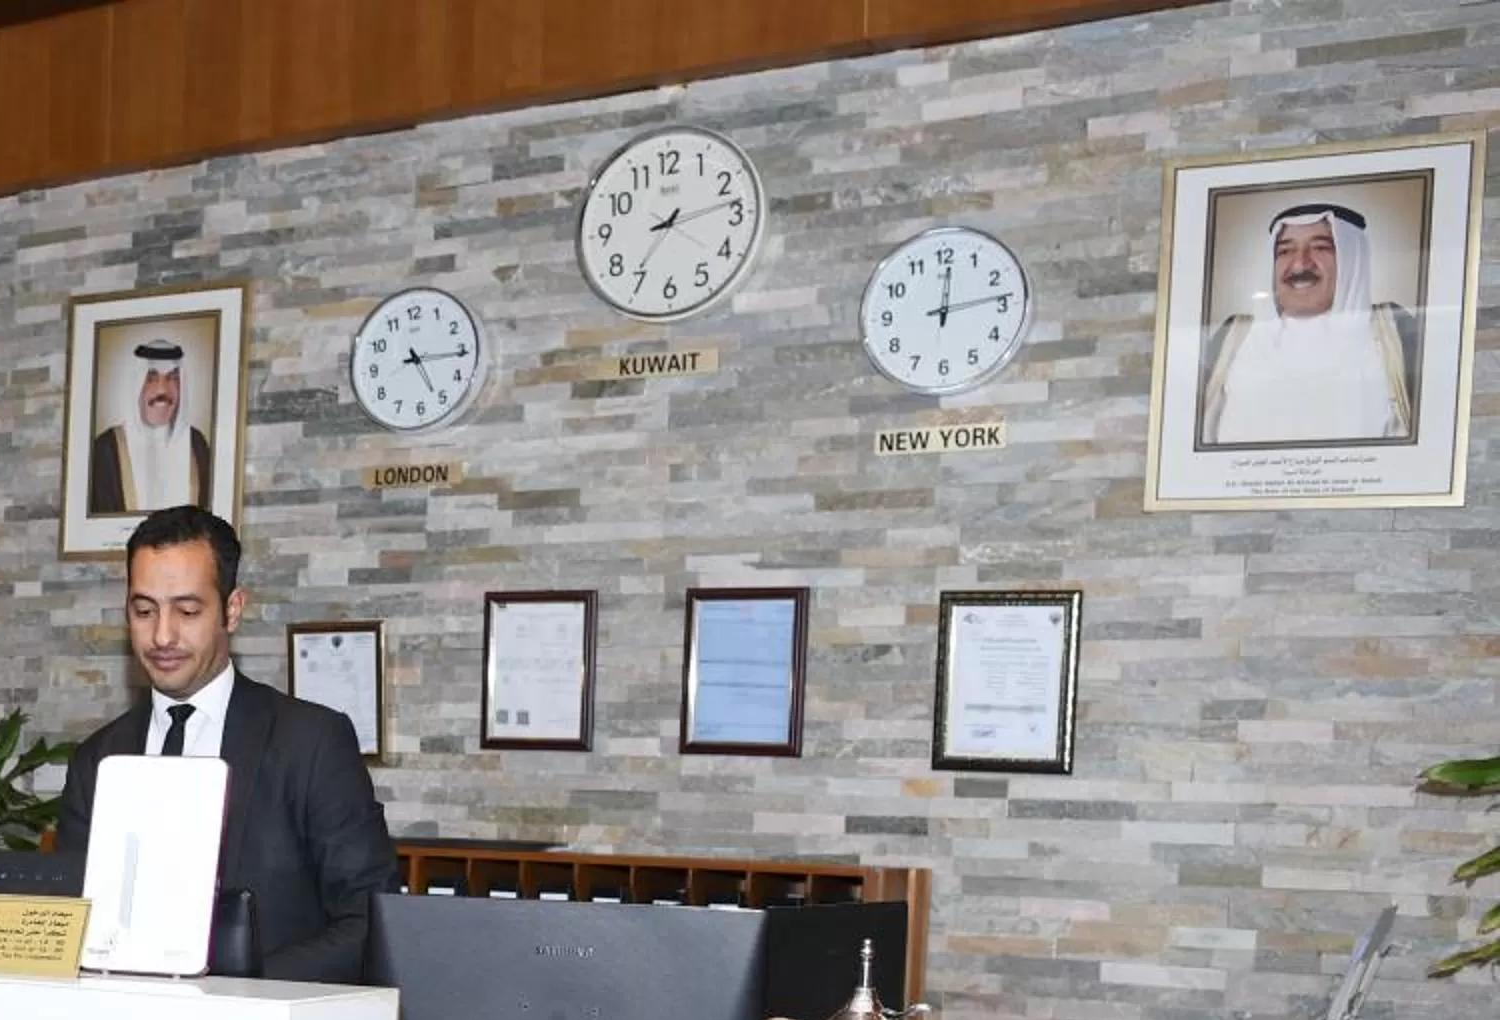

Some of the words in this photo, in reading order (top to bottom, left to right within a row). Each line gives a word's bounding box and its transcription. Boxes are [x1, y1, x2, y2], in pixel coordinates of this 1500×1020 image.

[658, 150, 680, 176] 12
[696, 152, 704, 177] 1
[631, 165, 651, 190] 11
[717, 171, 732, 196] 2
[609, 191, 633, 217] 10
[728, 201, 744, 227] 3
[597, 223, 613, 248] 9
[717, 237, 732, 260] 4
[934, 247, 954, 265] 12
[608, 253, 624, 277] 8
[908, 259, 925, 275] 11
[969, 252, 978, 269] 1
[693, 261, 710, 287] 5
[989, 270, 1001, 287] 2
[632, 271, 647, 295] 7
[663, 276, 677, 300] 6
[886, 282, 906, 299] 10
[406, 305, 422, 321] 12
[996, 296, 1009, 314] 3
[433, 307, 441, 321] 1
[881, 311, 893, 327] 9
[387, 318, 400, 333] 11
[449, 321, 460, 335] 2
[987, 326, 1000, 341] 4
[371, 338, 388, 354] 10
[457, 343, 468, 358] 3
[889, 337, 901, 353] 8
[618, 352, 701, 376] KUWAIT
[909, 355, 921, 371] 7
[967, 348, 979, 366] 5
[369, 364, 379, 379] 9
[452, 369, 462, 382] 4
[937, 359, 949, 376] 6
[376, 386, 387, 401] 8
[437, 390, 448, 404] 5
[393, 399, 403, 414] 7
[416, 401, 426, 416] 6
[878, 431, 930, 453] NEW
[940, 427, 1001, 448] YORK
[375, 465, 449, 486] LONDON
